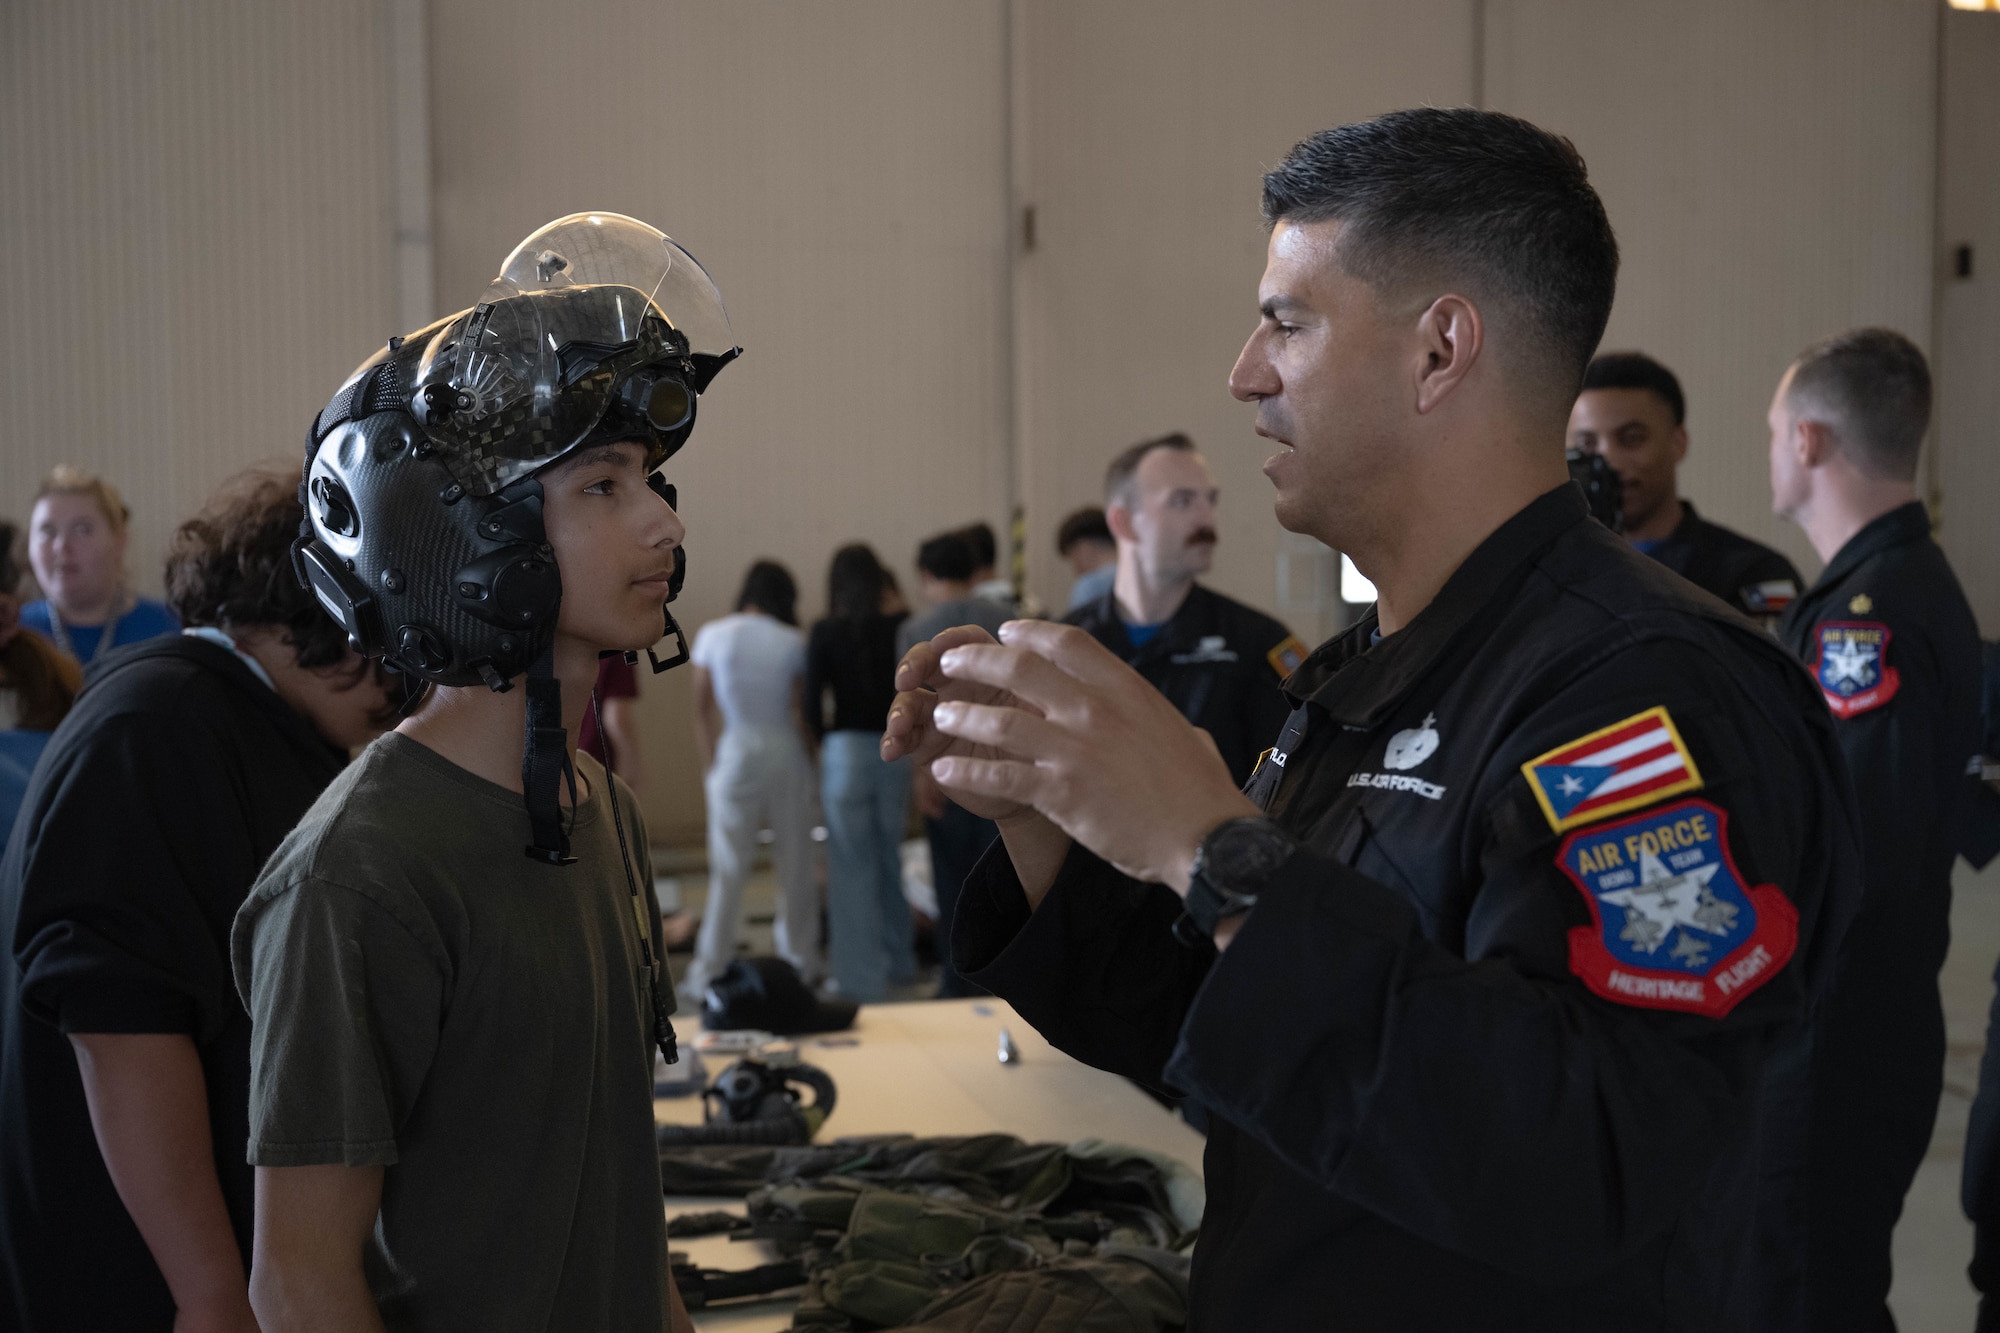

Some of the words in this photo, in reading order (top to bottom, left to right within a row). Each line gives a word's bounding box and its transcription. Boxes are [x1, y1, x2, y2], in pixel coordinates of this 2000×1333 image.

[1389, 774, 1446, 800] FORCE
[1578, 842, 1624, 876] AIR
[1624, 815, 1712, 862] FORCE
[1607, 970, 1705, 1002] HERITAGE
[1714, 944, 1772, 996] FLIGHT
